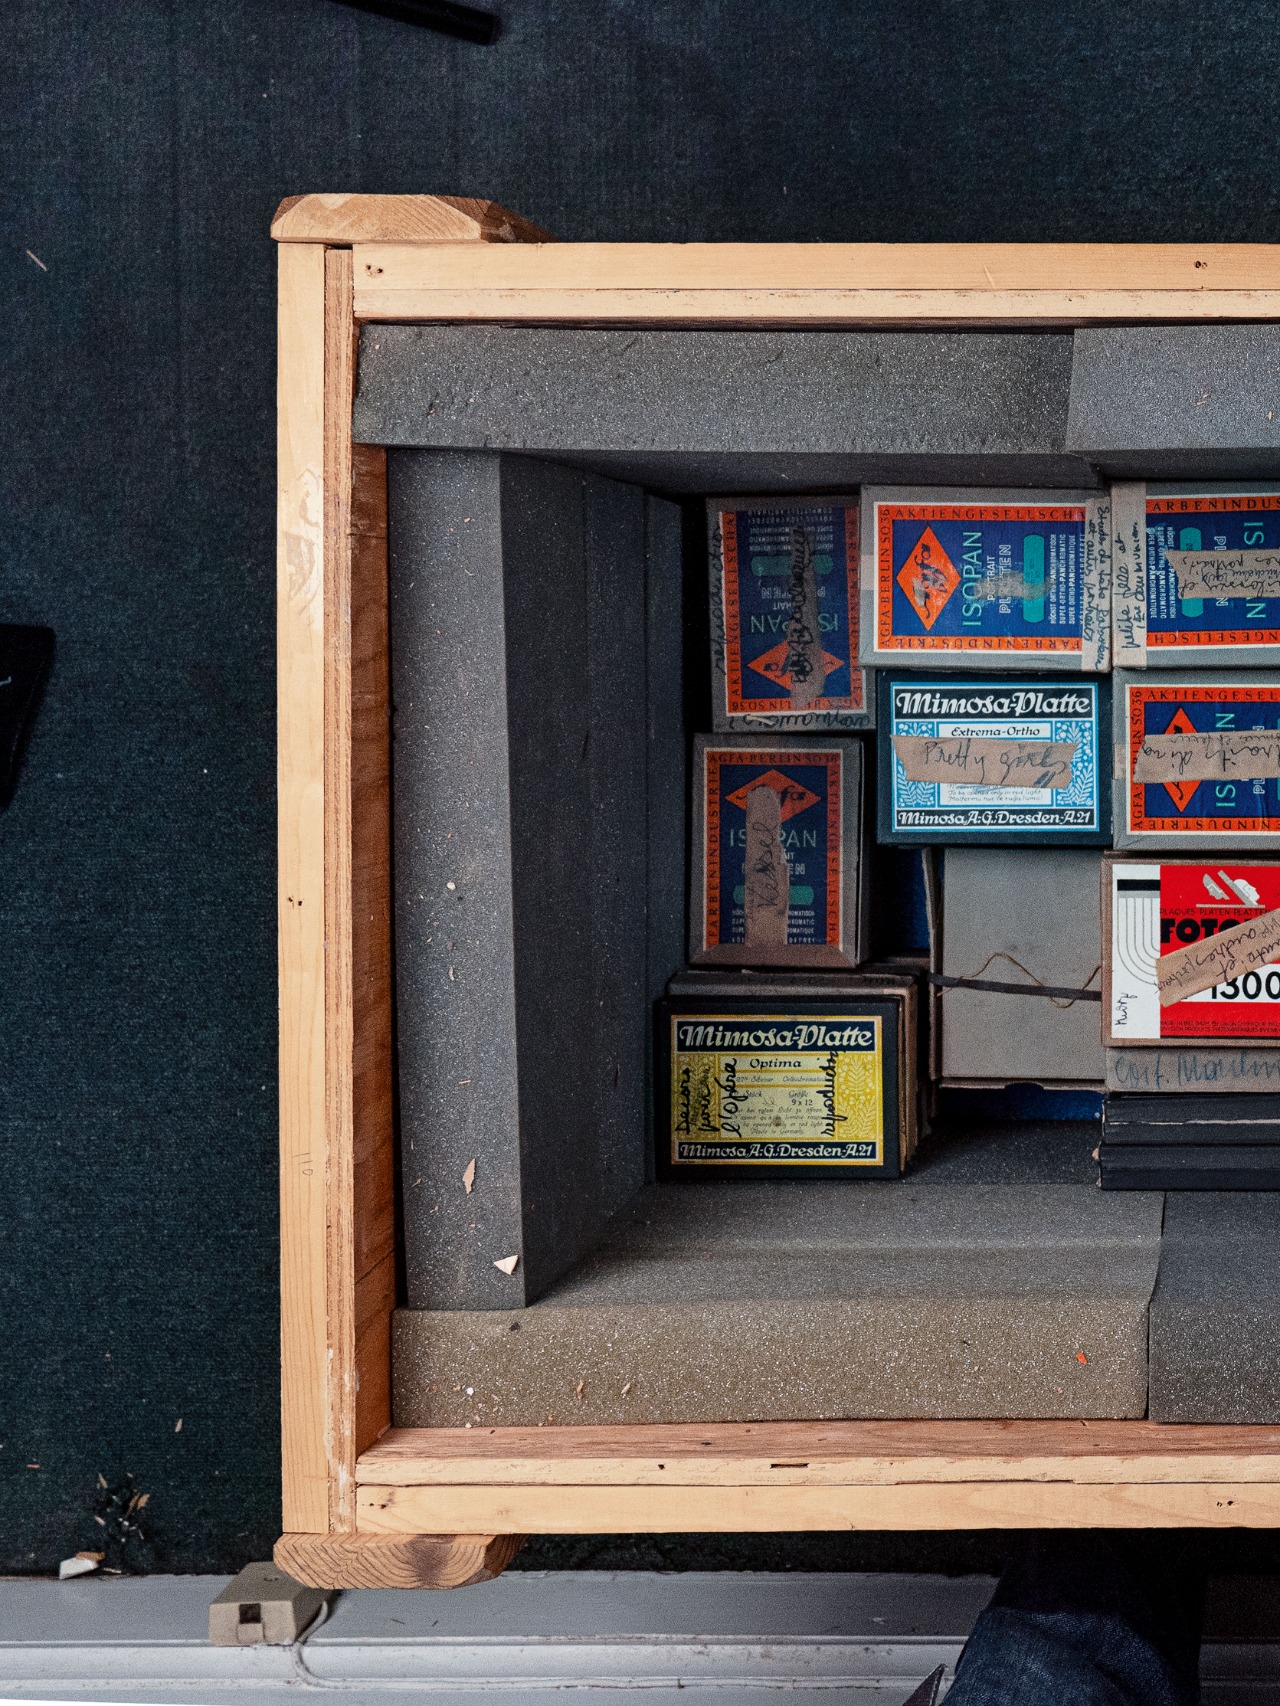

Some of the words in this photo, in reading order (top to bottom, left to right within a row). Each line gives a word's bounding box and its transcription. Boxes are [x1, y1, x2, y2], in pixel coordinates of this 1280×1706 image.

[962, 531, 982, 626] ISOPAN
[895, 638, 1080, 649] FARBENINDUSTRIE
[896, 692, 1090, 716] Mimosa-Platte
[951, 726, 1040, 737] Extrema-Ortho
[924, 738, 985, 784] Pretty
[680, 1025, 873, 1049] Mimosa-Platte
[750, 1058, 801, 1069] Optima
